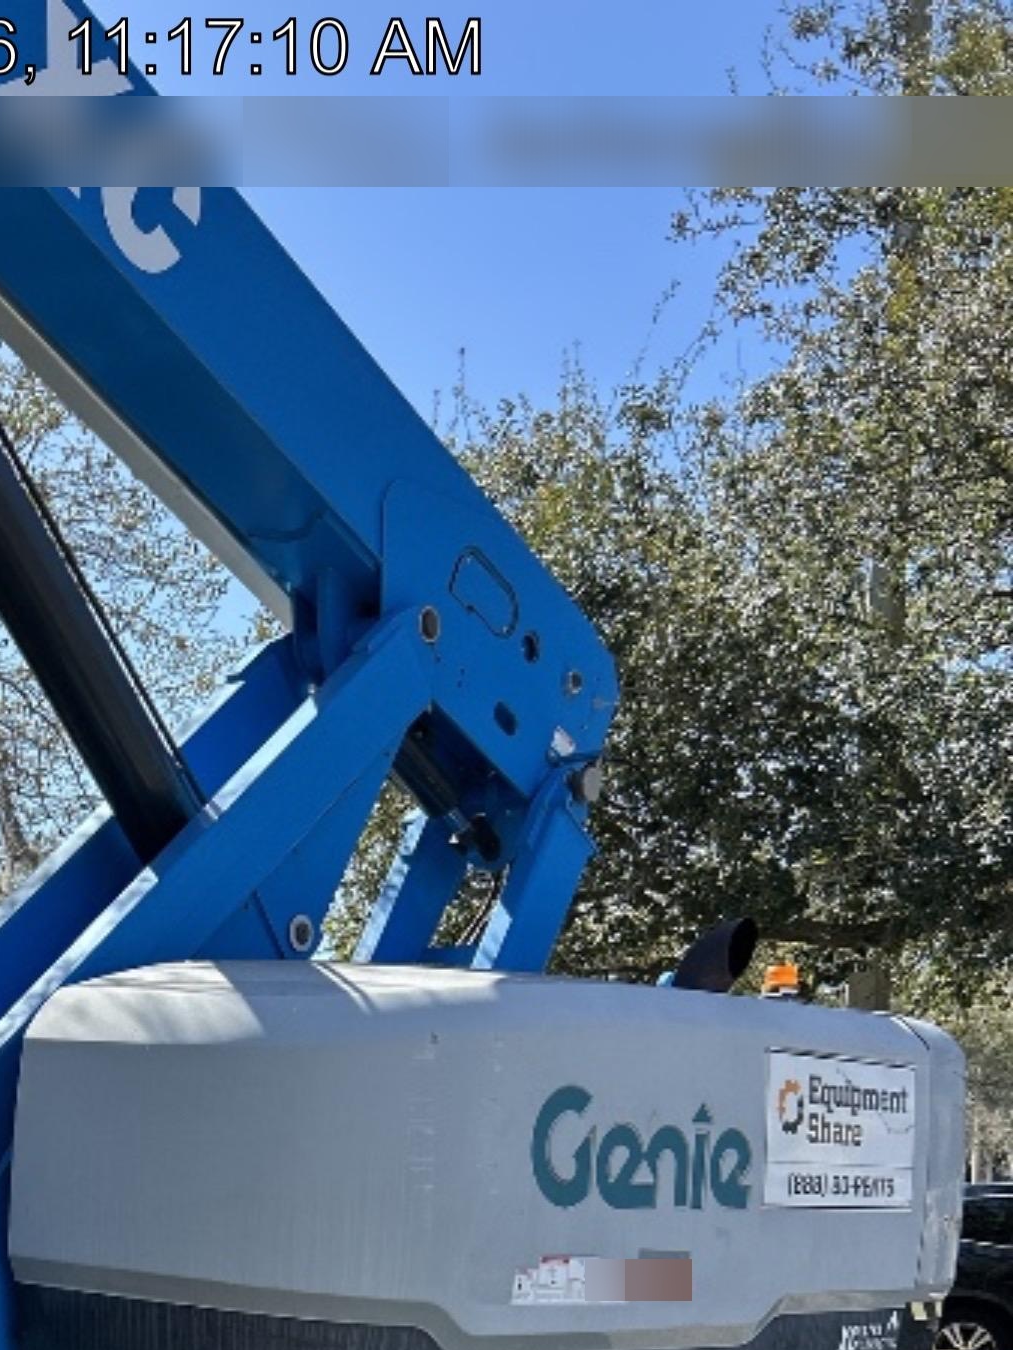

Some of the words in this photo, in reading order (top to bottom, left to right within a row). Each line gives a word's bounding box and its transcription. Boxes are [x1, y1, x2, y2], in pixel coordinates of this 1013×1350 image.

[808, 1074, 908, 1116] Equipment
[532, 1085, 752, 1210] Genie
[807, 1112, 862, 1147] Share
